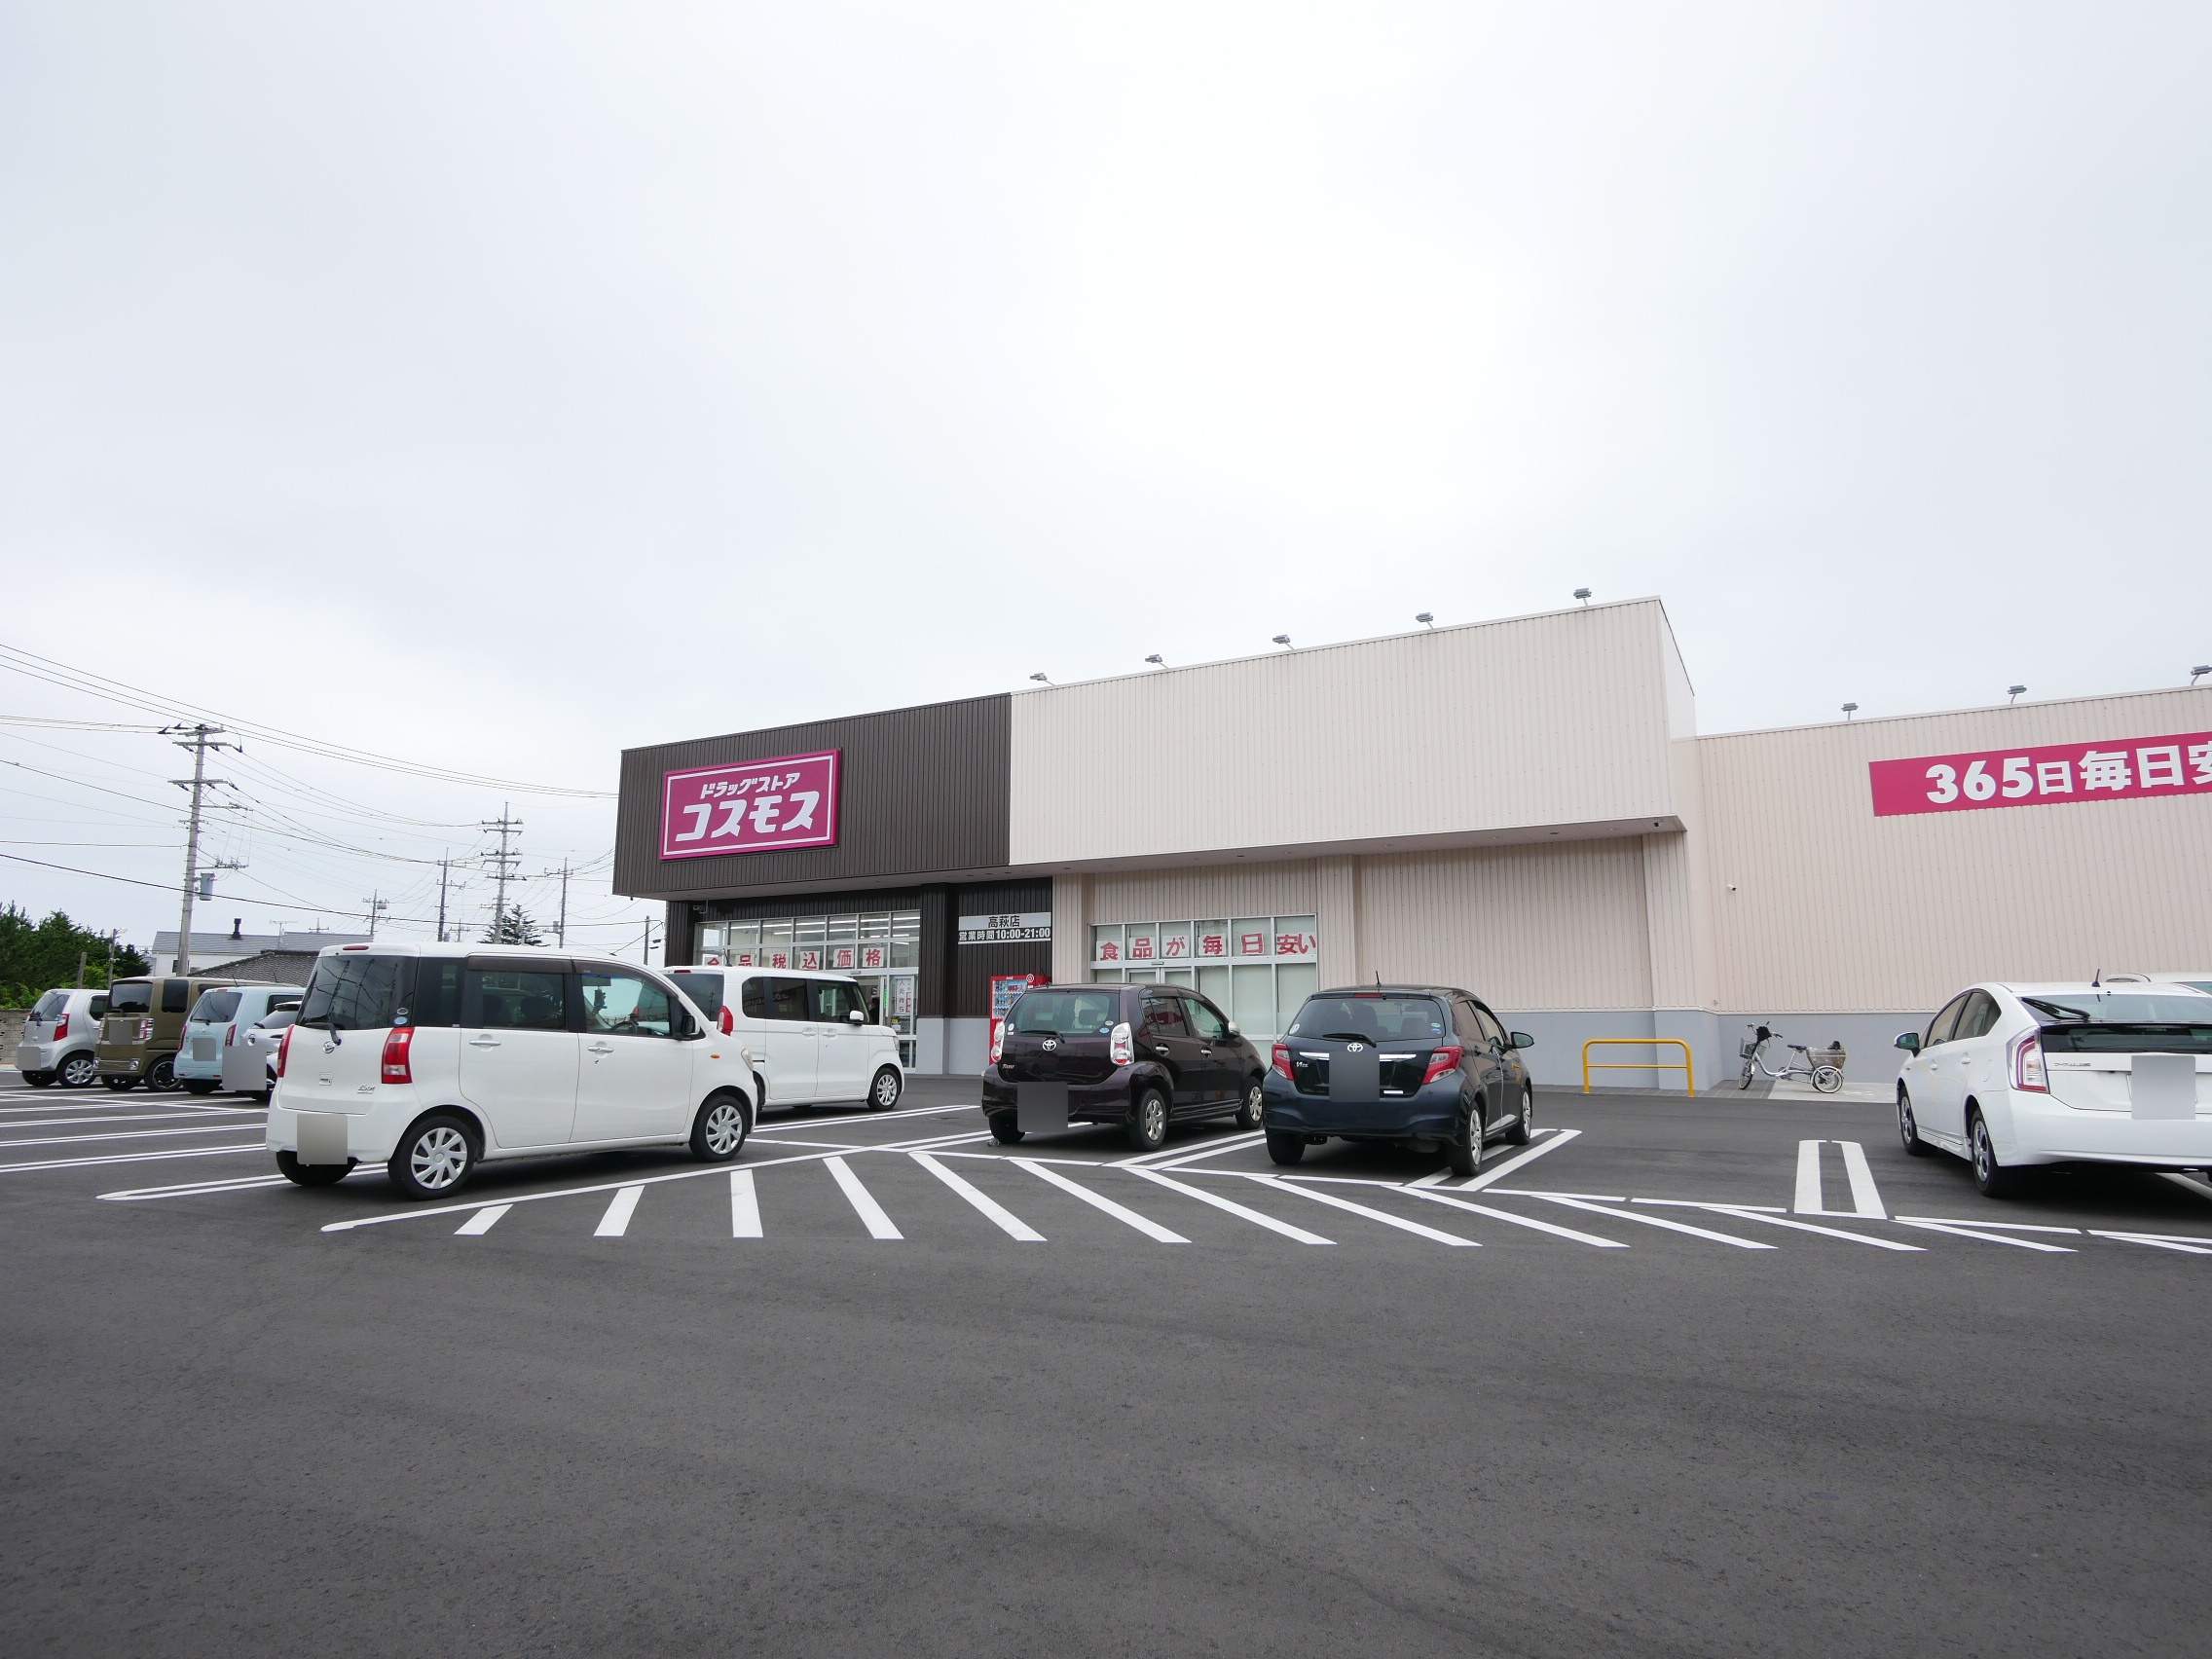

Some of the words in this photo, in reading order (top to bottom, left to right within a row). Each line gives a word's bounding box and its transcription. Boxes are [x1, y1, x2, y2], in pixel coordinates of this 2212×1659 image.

[699, 772, 800, 799] ドラッグストア
[675, 791, 820, 842] コスモス
[988, 915, 1020, 928] 高萩店
[1100, 933, 1316, 961] 食品が毎日安い
